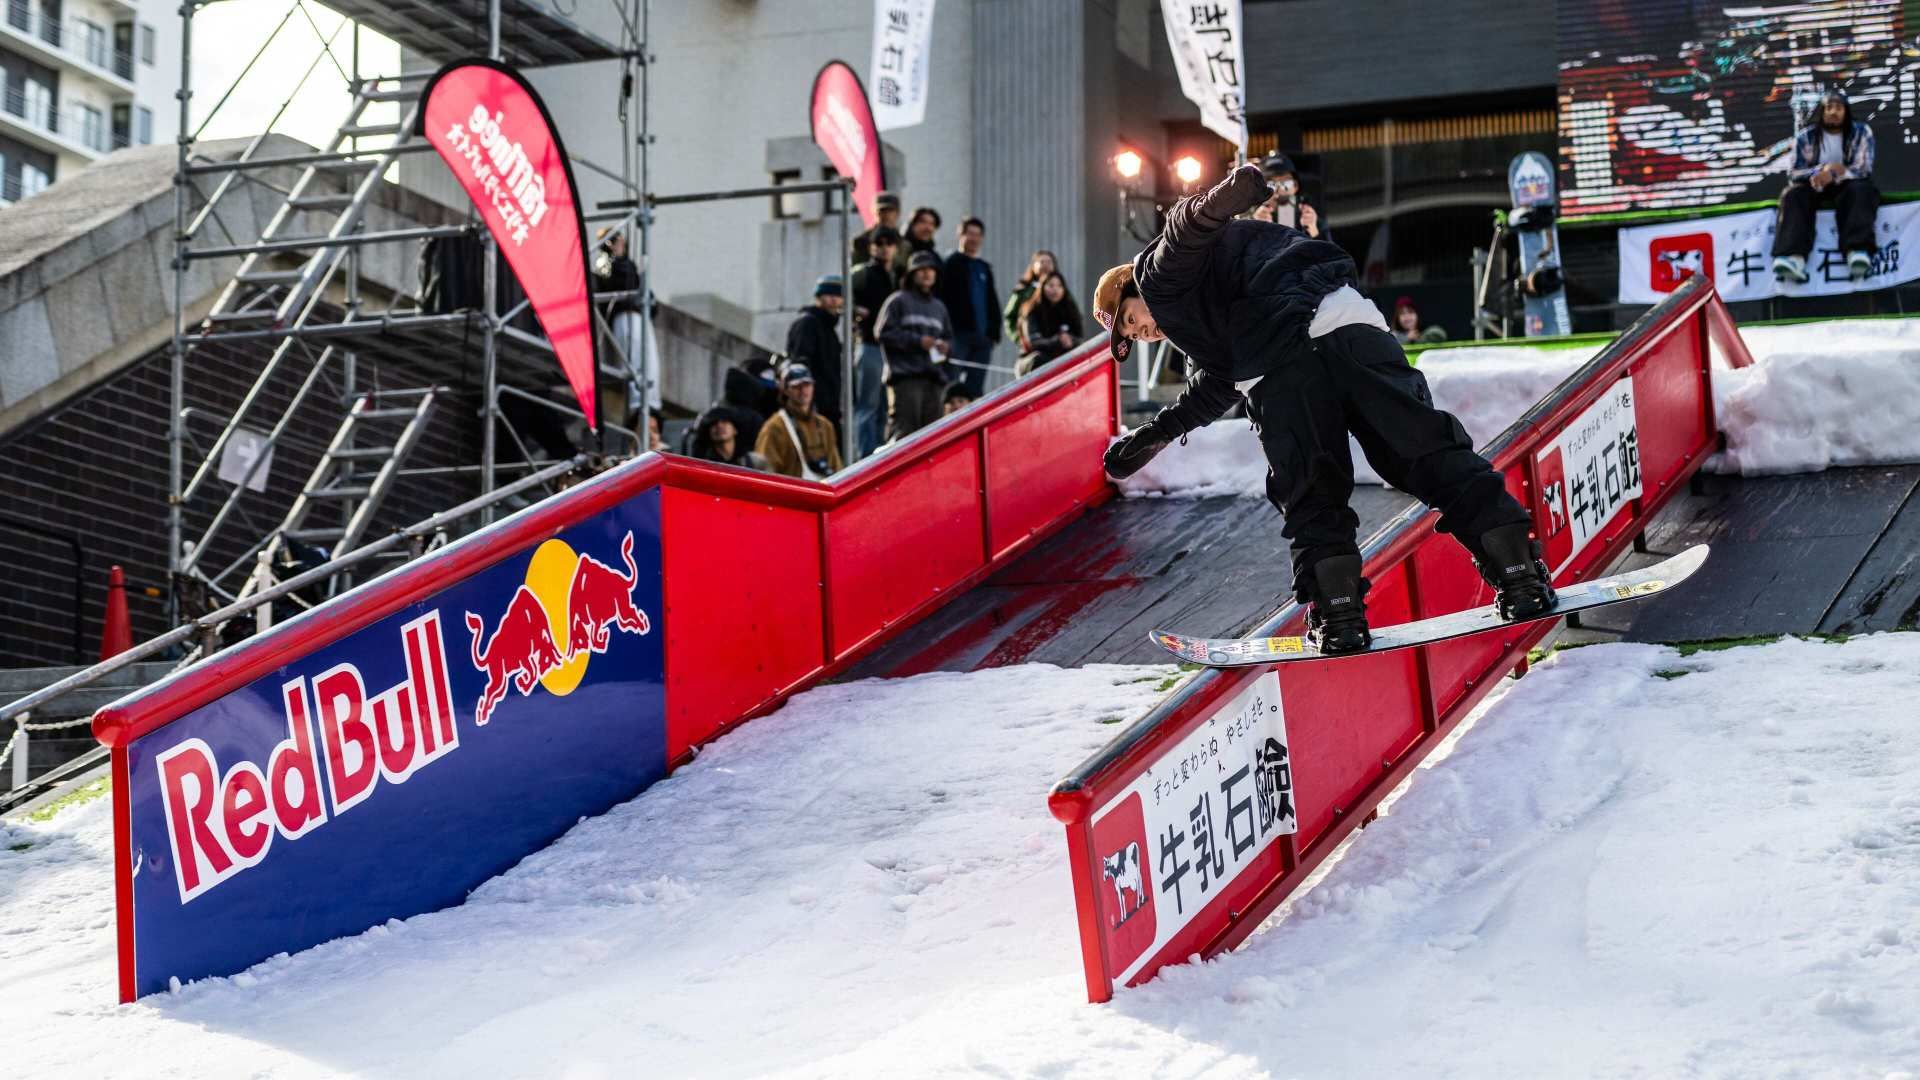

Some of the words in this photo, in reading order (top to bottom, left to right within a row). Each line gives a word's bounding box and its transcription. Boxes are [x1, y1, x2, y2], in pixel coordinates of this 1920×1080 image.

[156, 674, 328, 905] Red
[311, 608, 460, 817] Bull
[1154, 736, 1218, 806] ずっと変わらぬ
